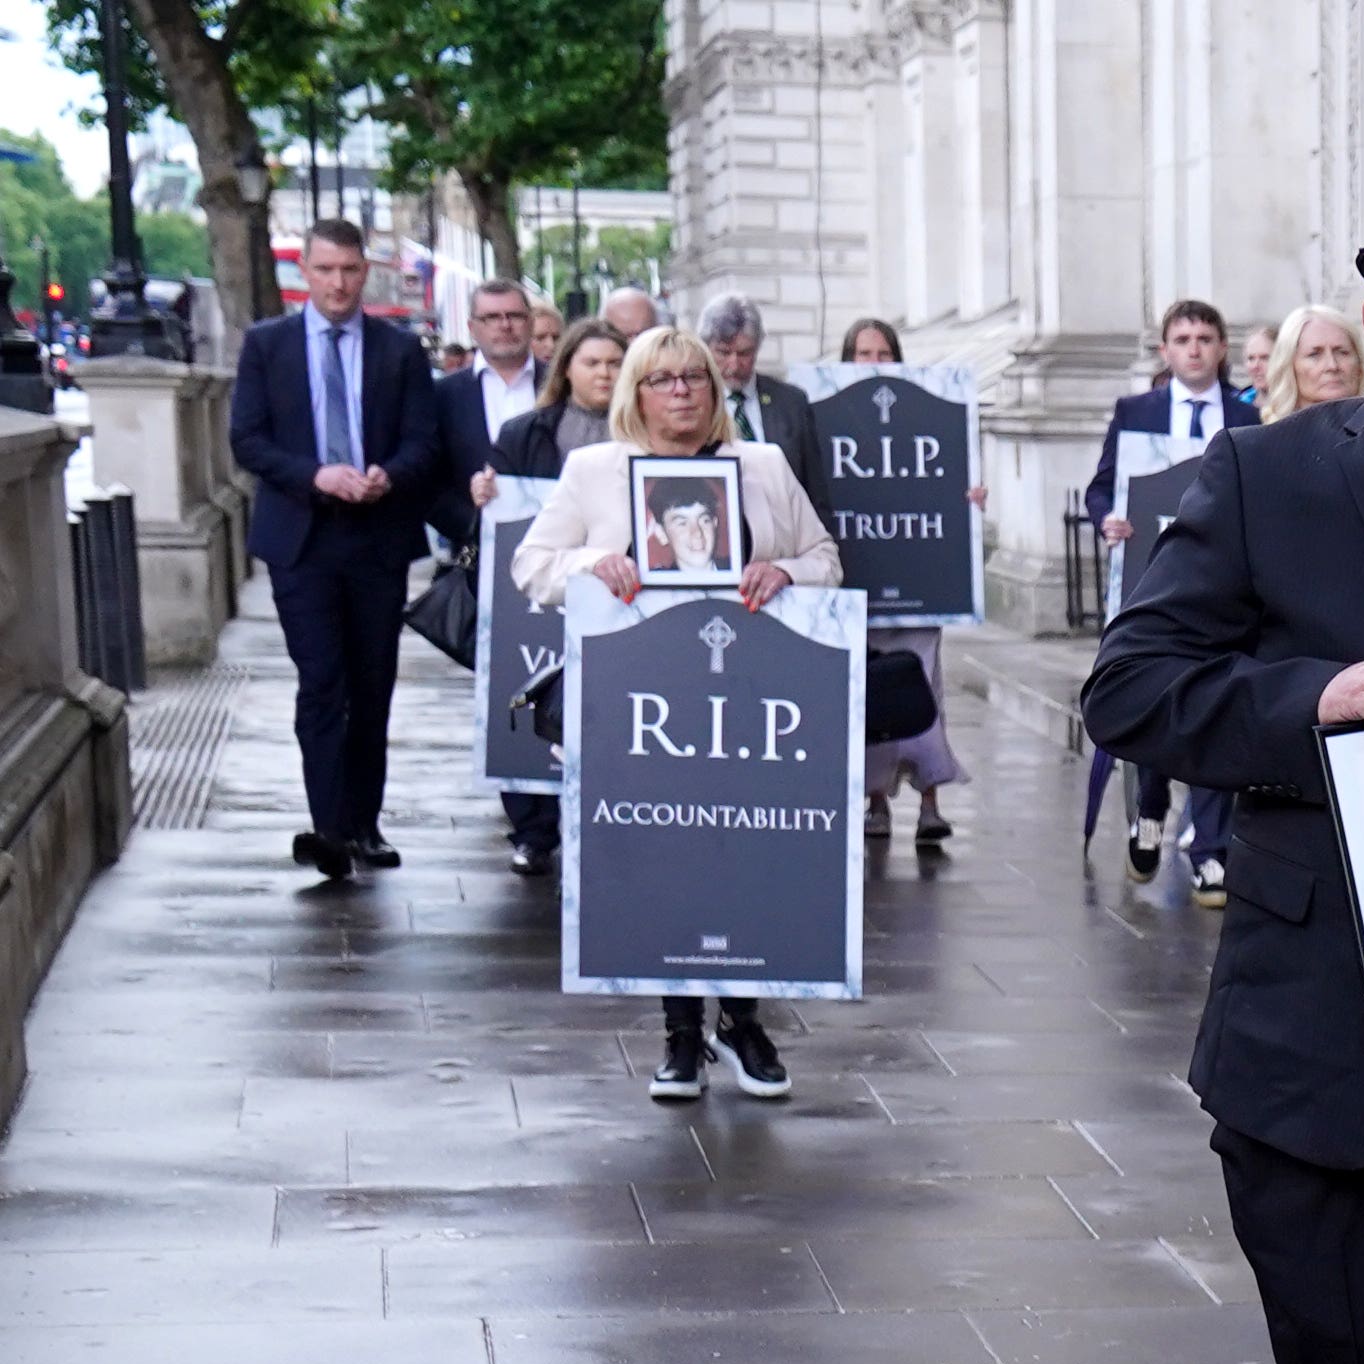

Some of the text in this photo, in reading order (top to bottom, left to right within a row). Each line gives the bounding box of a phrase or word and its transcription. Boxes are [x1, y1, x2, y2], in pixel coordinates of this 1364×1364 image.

[830, 434, 945, 479] R.I.P.
[627, 691, 808, 761] R.I.P.
[592, 798, 837, 832] ACCOUNTABILITY
